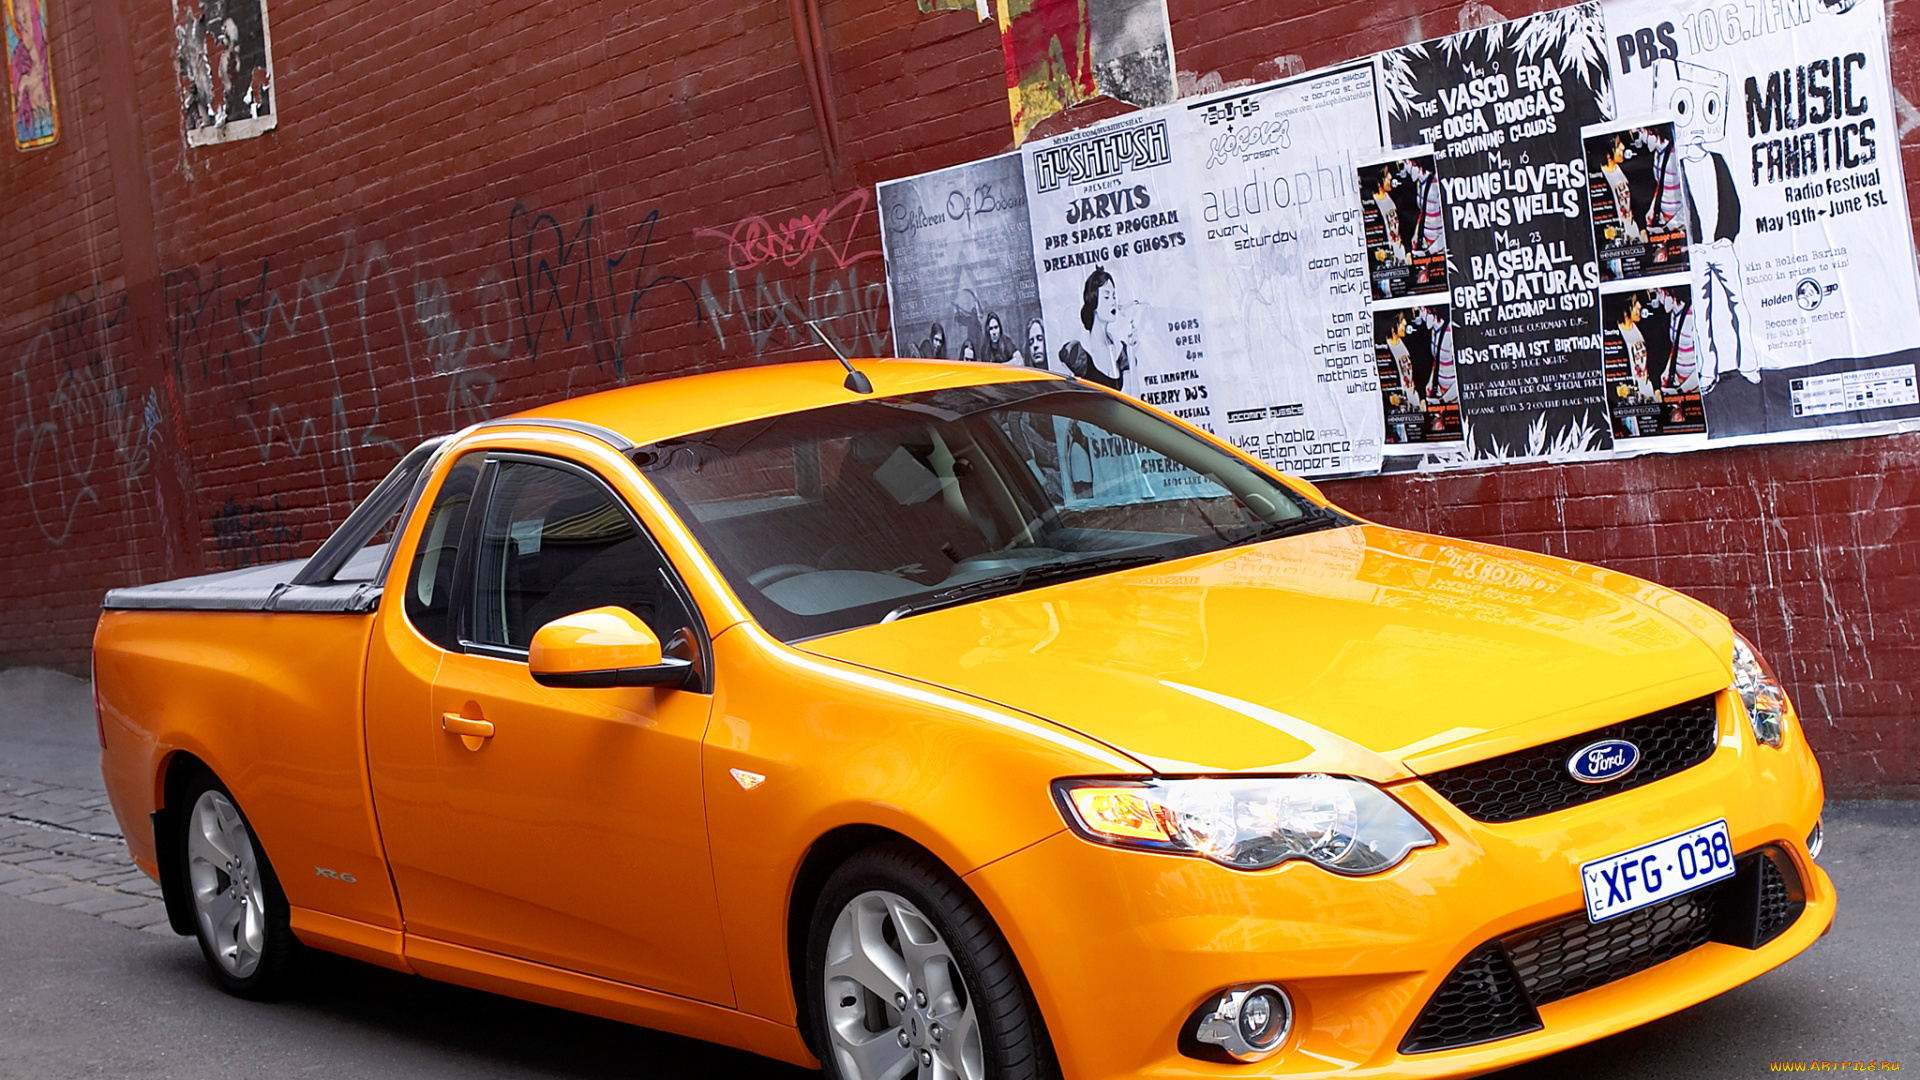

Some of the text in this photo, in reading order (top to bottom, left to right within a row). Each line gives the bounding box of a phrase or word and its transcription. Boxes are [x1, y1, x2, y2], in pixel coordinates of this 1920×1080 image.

[1616, 21, 1679, 75] PBS
[1462, 60, 1500, 79] May 9
[1419, 57, 1562, 119] THE VASCO ERA
[1744, 52, 1868, 138] MUSIC
[1419, 85, 1565, 144] THE OOGA BOOGAS
[1434, 115, 1557, 160] THE FROWNING CLOUDS
[1033, 119, 1171, 194] HUSHHUSH
[1242, 147, 1280, 163] present
[1487, 150, 1530, 170] May 16
[1750, 118, 1876, 187] FANATICS
[1083, 178, 1122, 194] PRESENTS
[1440, 158, 1586, 205] YOUNG LOVERS
[1785, 168, 1881, 203] Radio Festival
[891, 203, 946, 238] Children
[946, 190, 973, 229] Of
[1066, 184, 1151, 225] JARVIS
[1451, 197, 1511, 231] PARIS
[1512, 188, 1580, 225] WELLS
[1755, 189, 1888, 235] May 19th June 1st
[1044, 209, 1180, 250] PBR SPACE PROGRAM
[1207, 223, 1249, 240] every
[1322, 225, 1354, 239] andy
[1234, 231, 1299, 251] saturday
[1494, 230, 1542, 251] May 23
[1043, 247, 1110, 273] DREAMING
[1113, 243, 1129, 259] OF
[1133, 231, 1186, 254] GHOSTS
[1470, 240, 1573, 281] BASEBALL
[1811, 247, 1847, 260] Barina
[1308, 256, 1340, 270] dean
[1776, 271, 1786, 280] in
[1789, 265, 1816, 279] prizes
[1330, 267, 1364, 281] myles
[1330, 281, 1356, 296] nick
[1454, 279, 1499, 310] GREY
[1501, 261, 1599, 302] DATURAS
[1464, 290, 1594, 326] FAIT ACCOMPLI (SYD)
[1761, 293, 1793, 308] Holden
[1168, 318, 1200, 332] DOORS
[1332, 311, 1354, 324] tom
[1526, 318, 1567, 332] CUSTOMARY
[1765, 317, 1798, 329] Become
[1811, 310, 1845, 323] member
[1175, 333, 1201, 347] OPEN
[1326, 328, 1351, 340] ben
[1313, 338, 1347, 356] chris
[1457, 347, 1474, 365] US
[1488, 341, 1527, 360] THEM
[1528, 339, 1551, 357] 1ST
[1554, 334, 1602, 353] BIRTHDAY
[1324, 352, 1359, 368] logan
[1144, 369, 1200, 386] THE IMMORTAL
[1317, 366, 1368, 384] matthias
[1140, 384, 1208, 406] CHERRY DJ'S
[1346, 381, 1377, 395] white
[1227, 403, 1304, 423] upcoming guests
[1229, 434, 1260, 449] luke
[1266, 428, 1315, 446] chable
[1303, 440, 1351, 456] vance
[1276, 456, 1341, 473] chapers
[1588, 746, 1626, 775] Ford
[315, 866, 357, 883] XR6
[1589, 872, 1604, 911] VIC
